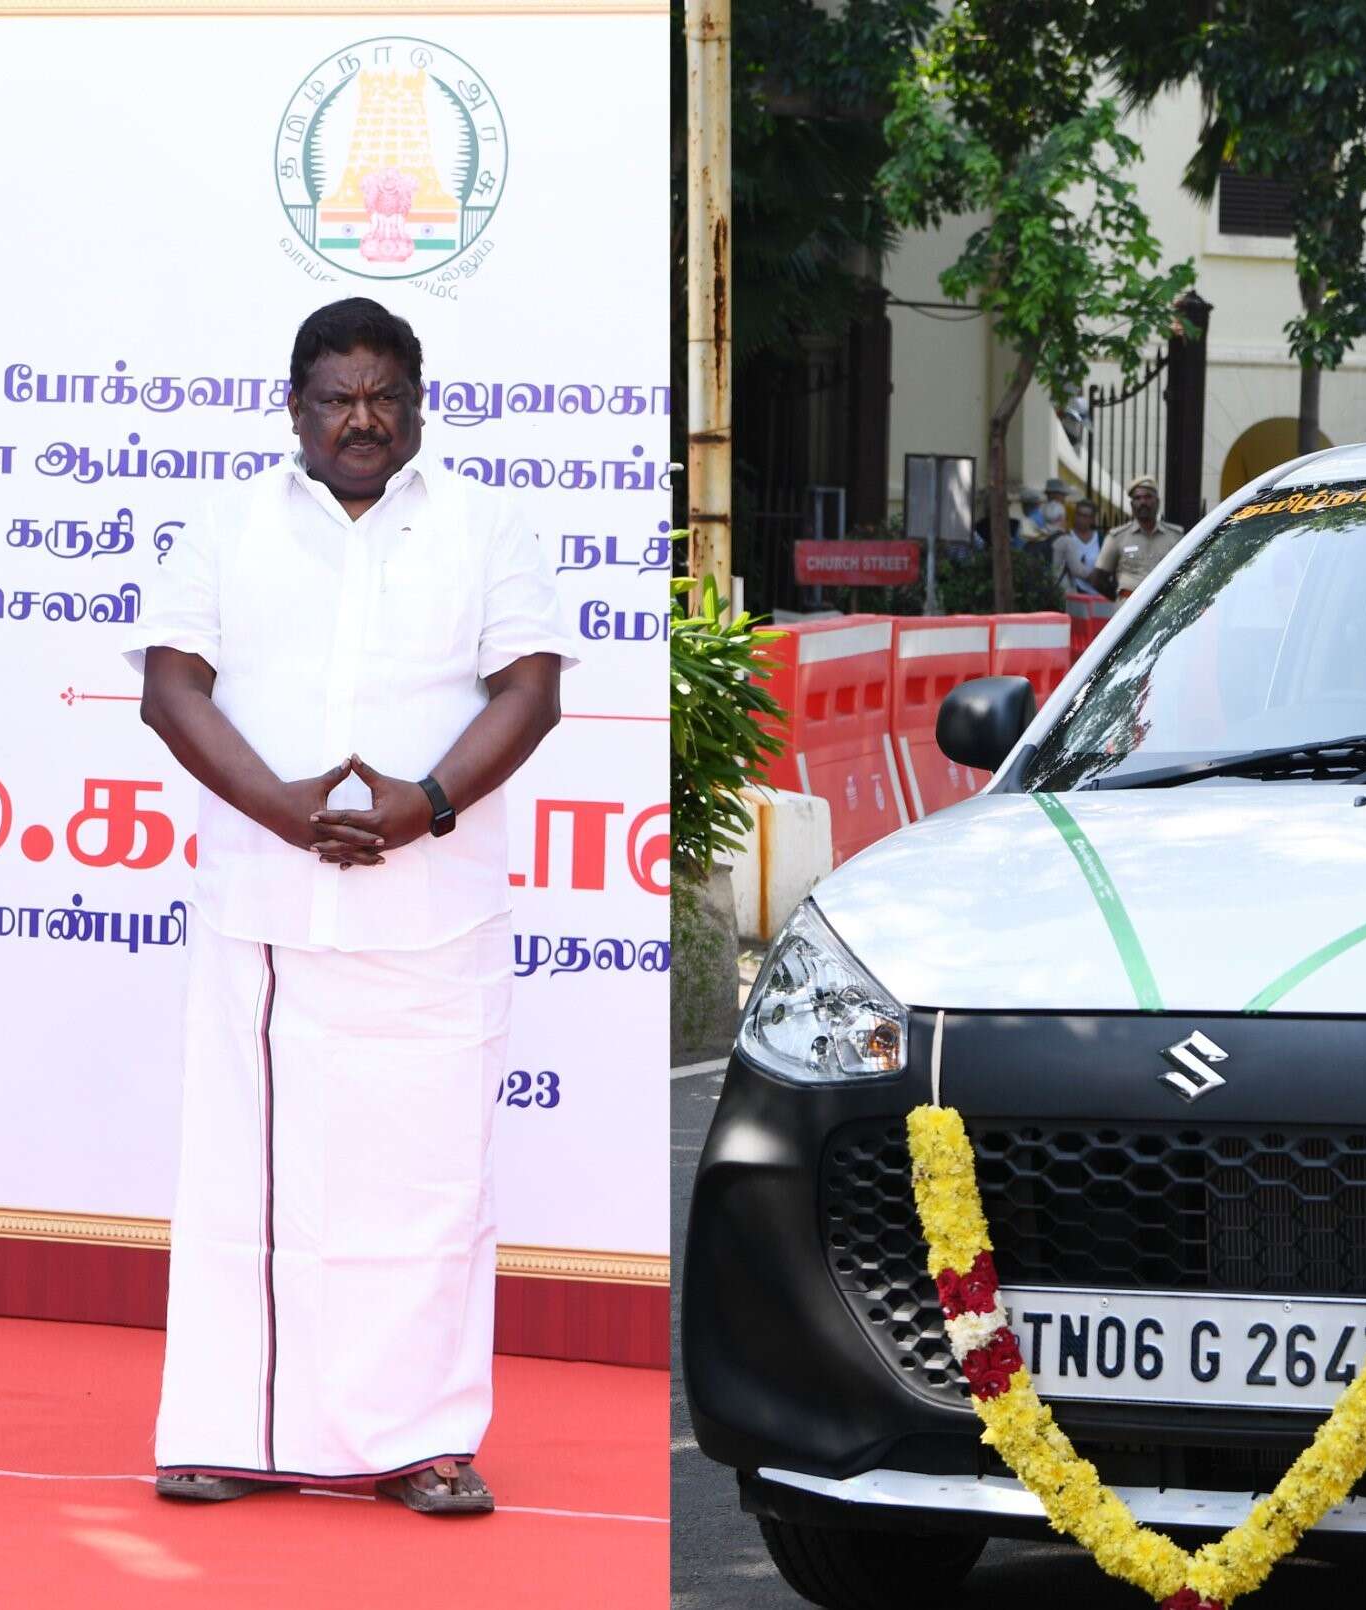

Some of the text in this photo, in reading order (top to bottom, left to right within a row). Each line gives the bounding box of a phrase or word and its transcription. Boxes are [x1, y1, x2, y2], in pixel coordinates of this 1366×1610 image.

[6, 507, 135, 560] கருதி
[806, 557, 910, 571] CHURCH STREET
[496, 1070, 560, 1109] 23
[1023, 1312, 1164, 1381] TN06
[1190, 1320, 1221, 1383] G
